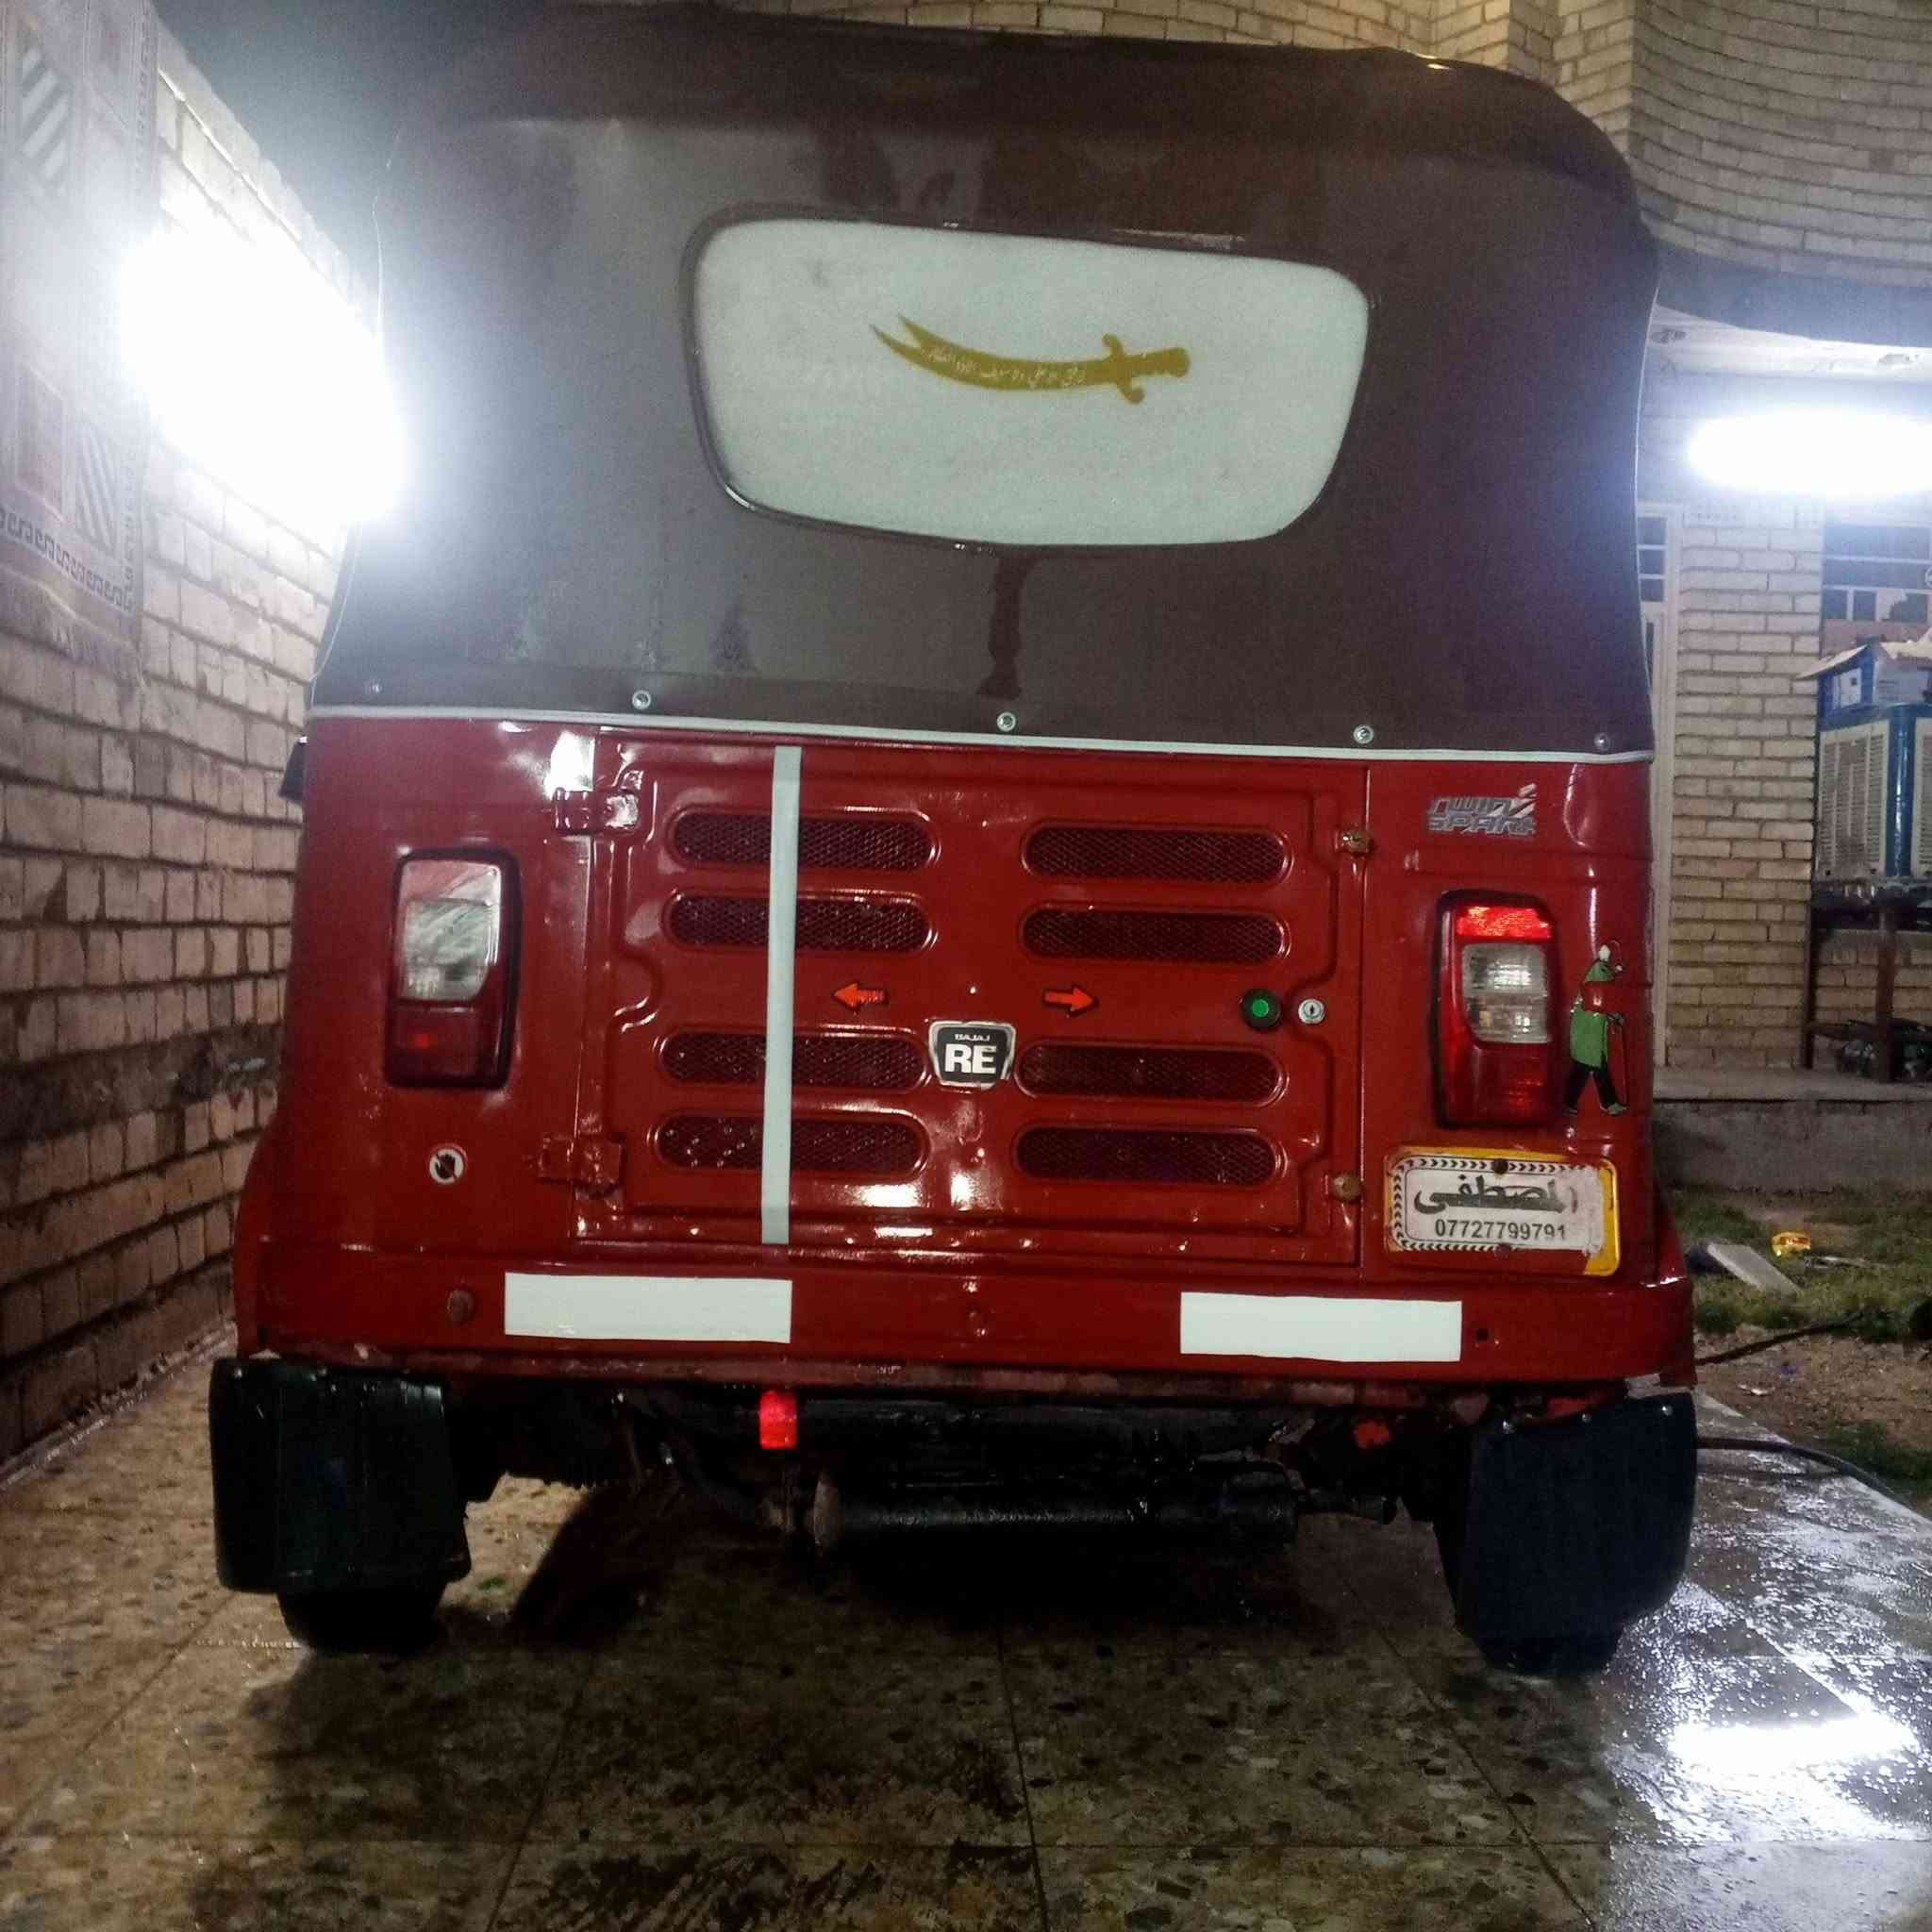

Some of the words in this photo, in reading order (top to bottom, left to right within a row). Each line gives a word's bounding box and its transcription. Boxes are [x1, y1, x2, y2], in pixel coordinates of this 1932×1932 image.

[954, 1033, 991, 1041] BAJAJ
[944, 1043, 997, 1074] RE
[1434, 1218, 1566, 1241] 07727799791
